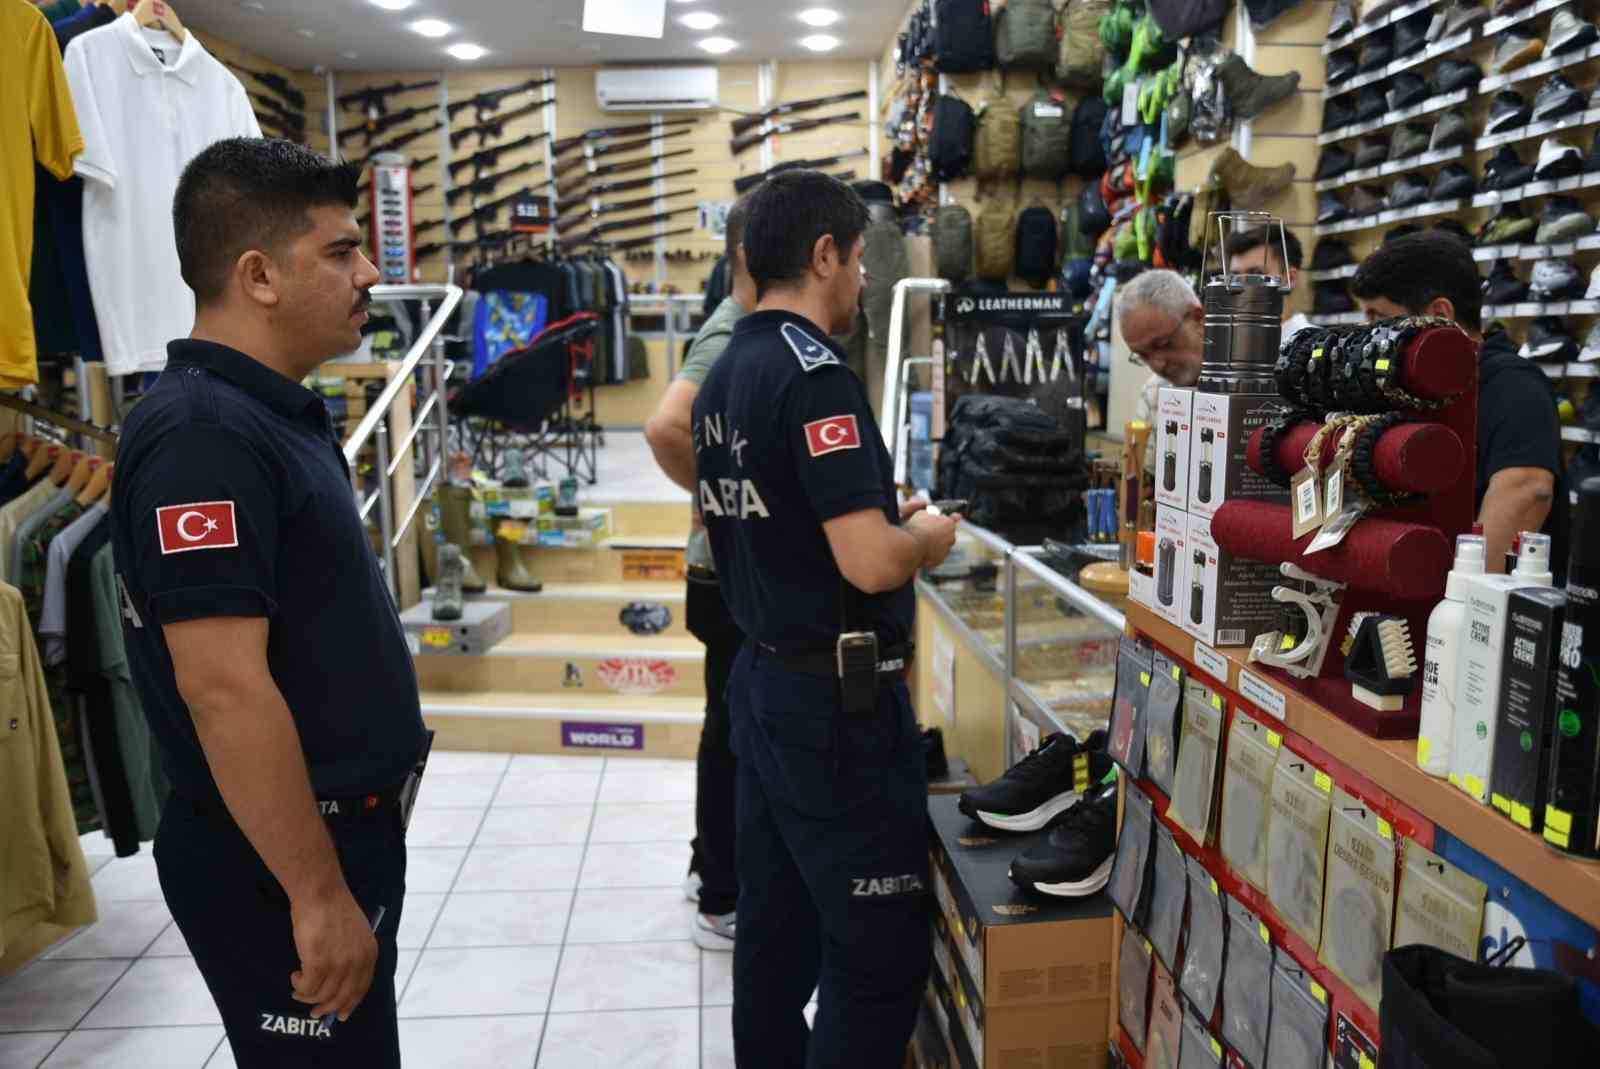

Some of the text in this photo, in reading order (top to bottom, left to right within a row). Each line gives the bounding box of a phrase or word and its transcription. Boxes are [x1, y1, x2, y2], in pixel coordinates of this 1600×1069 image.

[978, 298, 1062, 310] LEATHERMAN
[569, 732, 635, 746] WORLD
[319, 800, 339, 815] TA
[853, 875, 922, 896] ZABITA
[261, 1013, 331, 1037] ZABITA
